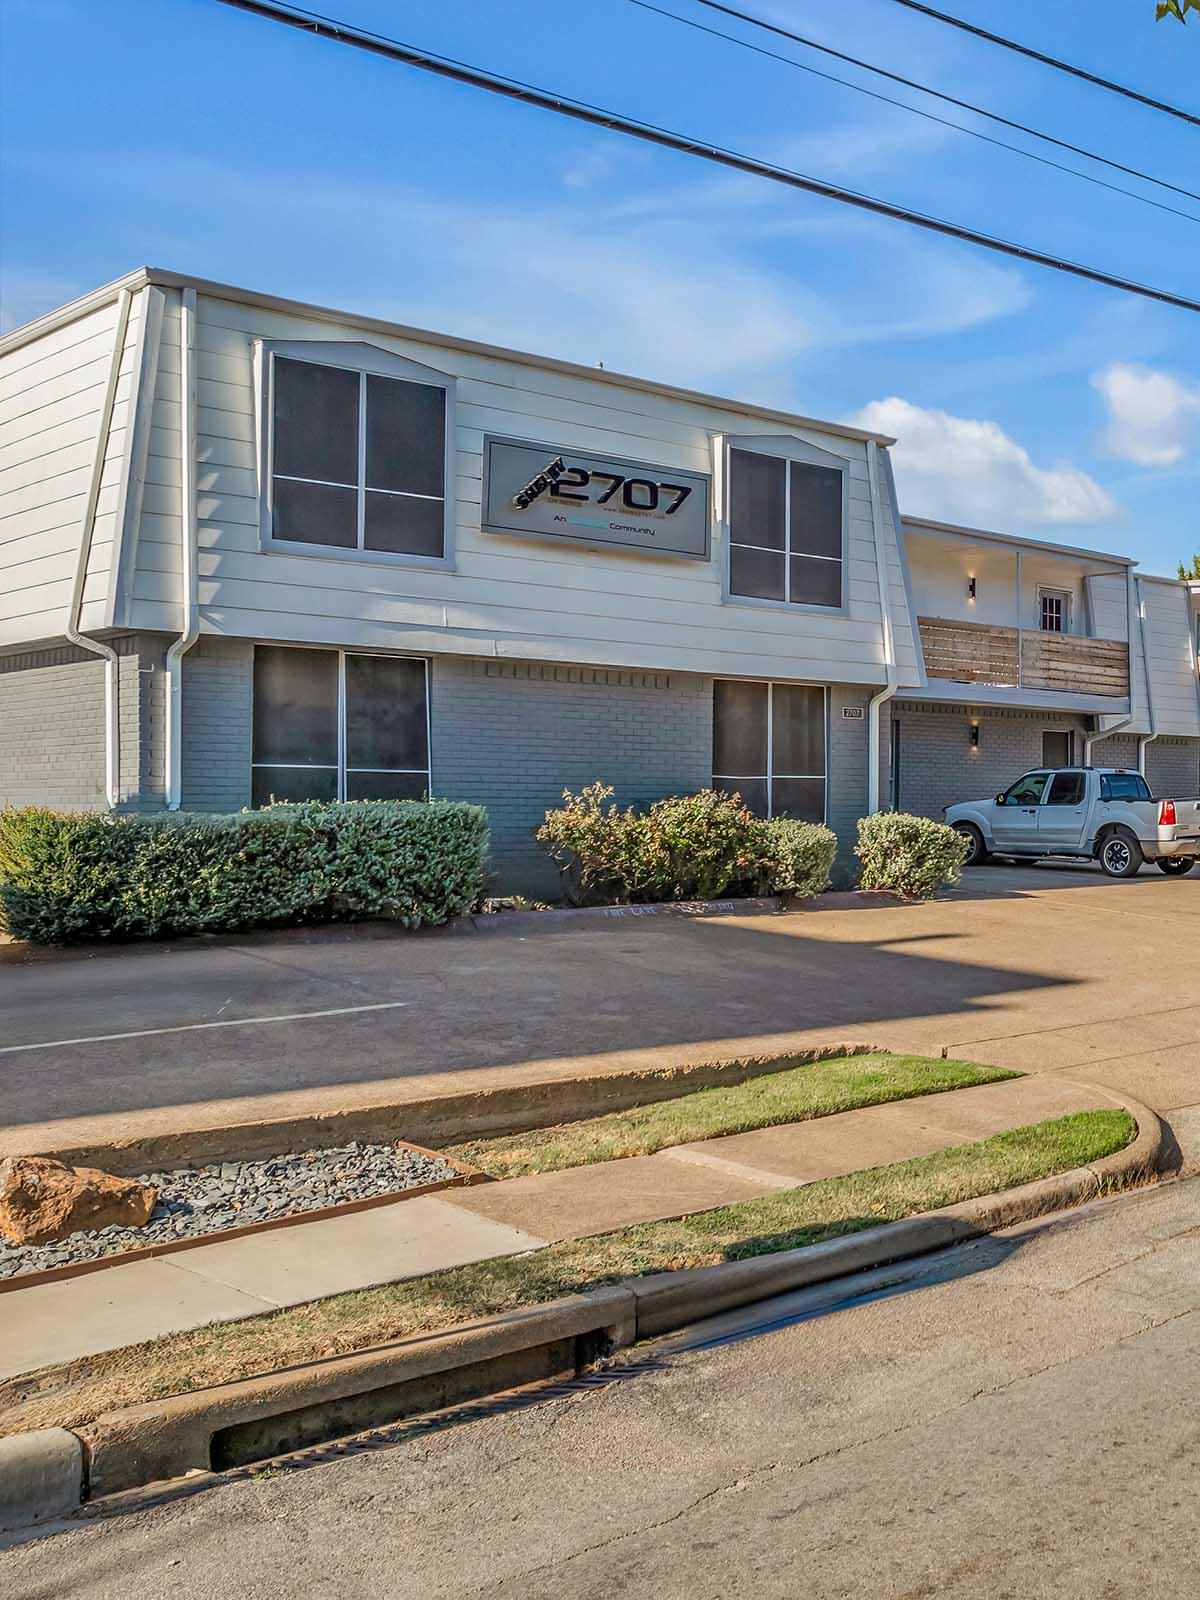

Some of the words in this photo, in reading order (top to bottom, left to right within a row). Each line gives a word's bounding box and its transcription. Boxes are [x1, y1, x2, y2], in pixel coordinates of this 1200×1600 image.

[550, 467, 693, 514] 2707
[609, 522, 656, 536] Community
[845, 709, 861, 717] 2707
